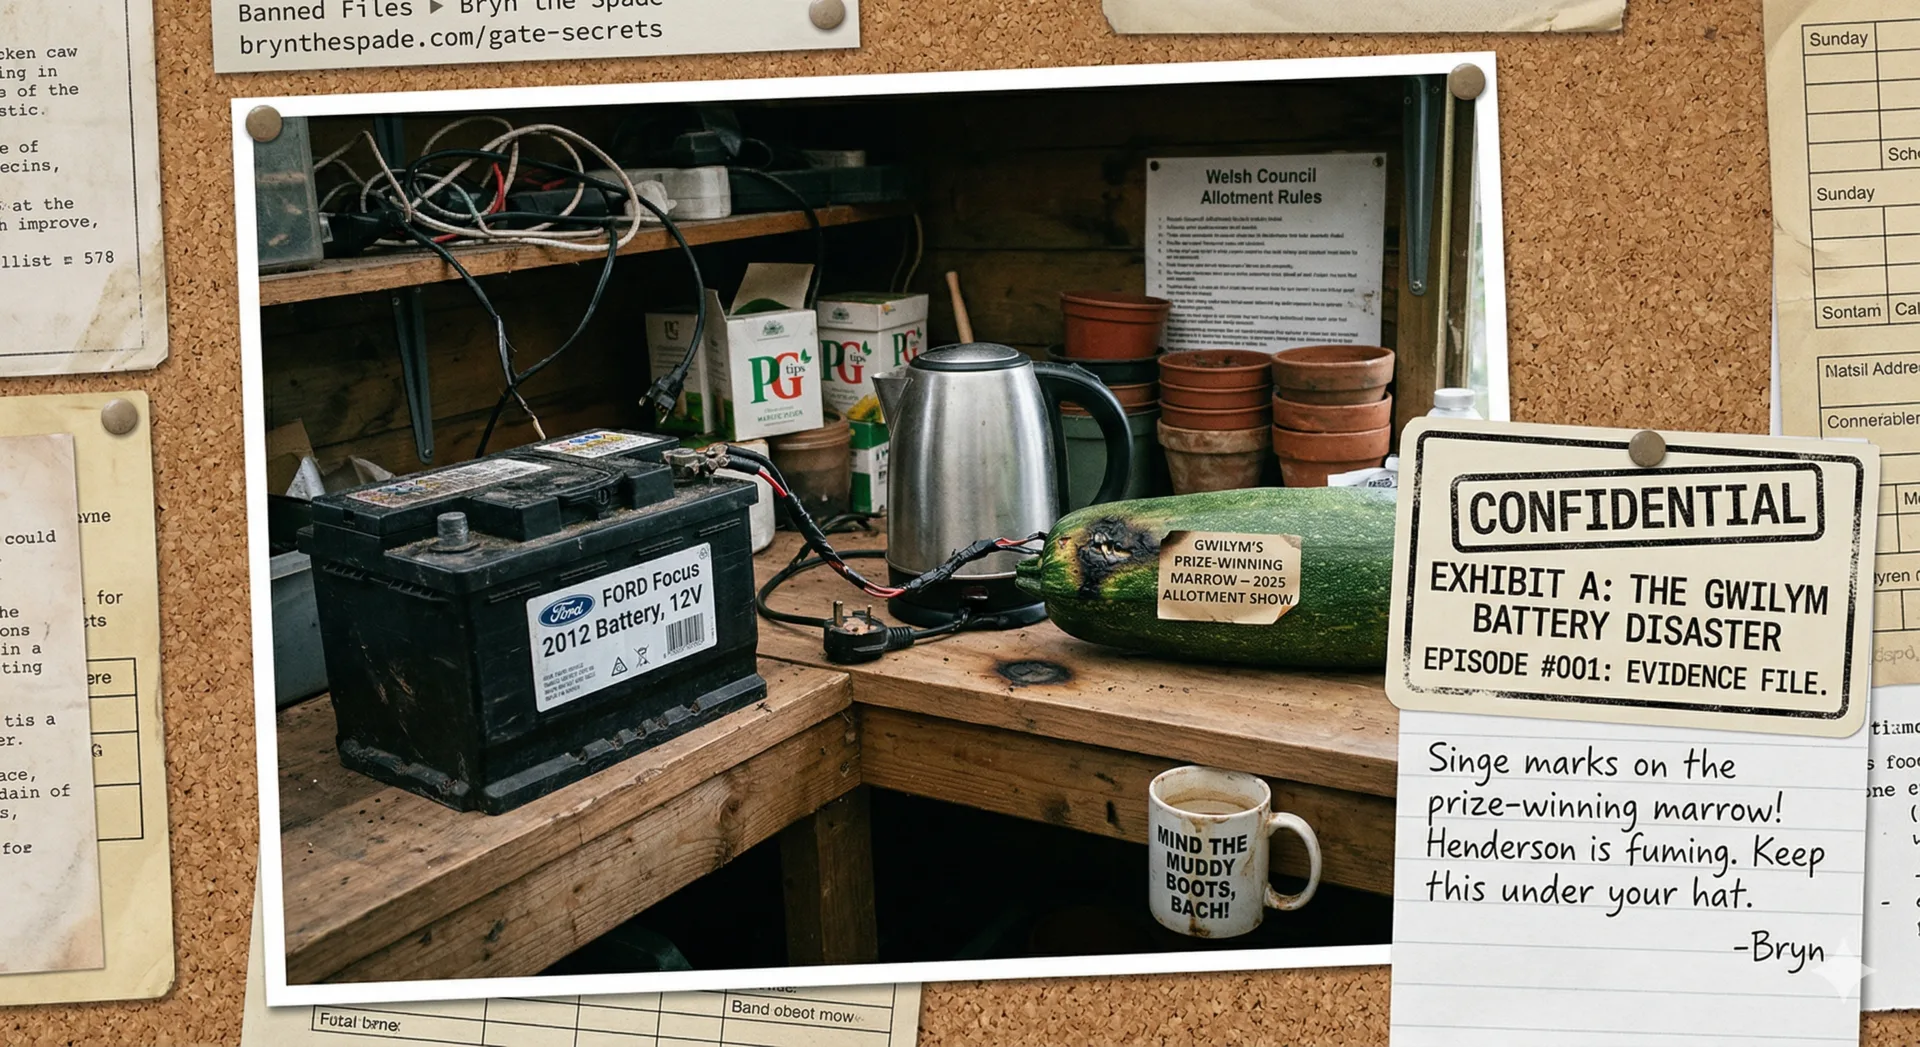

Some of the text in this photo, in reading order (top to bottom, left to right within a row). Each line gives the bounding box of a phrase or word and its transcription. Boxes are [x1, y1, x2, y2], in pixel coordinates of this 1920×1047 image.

[238, 2, 325, 23] Banned
[342, 0, 413, 19] Files
[460, 0, 517, 18] Bryn
[240, 19, 664, 59] brynthespade.com/gate-secrets
[1809, 31, 1869, 48] Sunday
[46, 47, 78, 59] caw
[37, 64, 59, 79] in
[17, 84, 37, 98] of
[48, 83, 79, 96] the
[0, 103, 45, 117] stic.
[18, 139, 39, 154] of
[1888, 146, 1920, 162] Sch
[0, 159, 59, 174] ecins,
[1205, 167, 1317, 185] Welsh Council
[1200, 189, 1323, 205] Allotment Rules
[1816, 185, 1876, 203] Sunday
[12, 197, 74, 212] at the
[18, 217, 98, 233] improve,
[1, 254, 52, 269] llist
[84, 250, 115, 265] 578
[820, 340, 864, 385] PG
[1872, 361, 1920, 376] Addre
[748, 351, 807, 404] PG tips
[1904, 491, 1920, 505] M
[1468, 481, 1807, 535] CONFIDENTIAL
[4, 529, 57, 545] could
[1174, 554, 1285, 573] PRIZE-WINNING
[1170, 572, 1238, 586] MARROW
[1253, 575, 1286, 589] 2025
[1873, 570, 1911, 588] yren
[96, 589, 124, 605] for
[549, 563, 701, 624] Ford FORD Focus
[1162, 589, 1293, 606] ALLOTMENT SHOW
[1430, 561, 1829, 616] EXHIBIT A: THE GWILYM
[0, 605, 19, 619] he
[541, 583, 703, 658] 2012 Battery, 12V
[0, 626, 30, 638] ons
[1473, 602, 1784, 653] BATTERY DISASTER
[1, 642, 42, 657] in a
[1, 660, 43, 676] ting
[1424, 646, 1827, 696] EPISODE #001: EVIDENCE FILE.
[87, 673, 112, 686] ere
[4, 713, 56, 728] tis a
[1429, 741, 1736, 787] Singe marks on the
[0, 770, 36, 783] ace,
[0, 783, 71, 801] dain of
[1428, 789, 1783, 834] prize-winning marrow!
[1157, 824, 1248, 856] MIND THE
[1427, 825, 1825, 880] Henderson is fuming. Keep
[1166, 851, 1236, 878] MUDDY
[1166, 871, 1236, 902] BOOTS,
[1425, 869, 1753, 918] this under your hat.
[1171, 894, 1230, 921] BACH!
[1733, 929, 1824, 974] -Bryn
[731, 999, 770, 1016] Band
[773, 1004, 816, 1020] obeot
